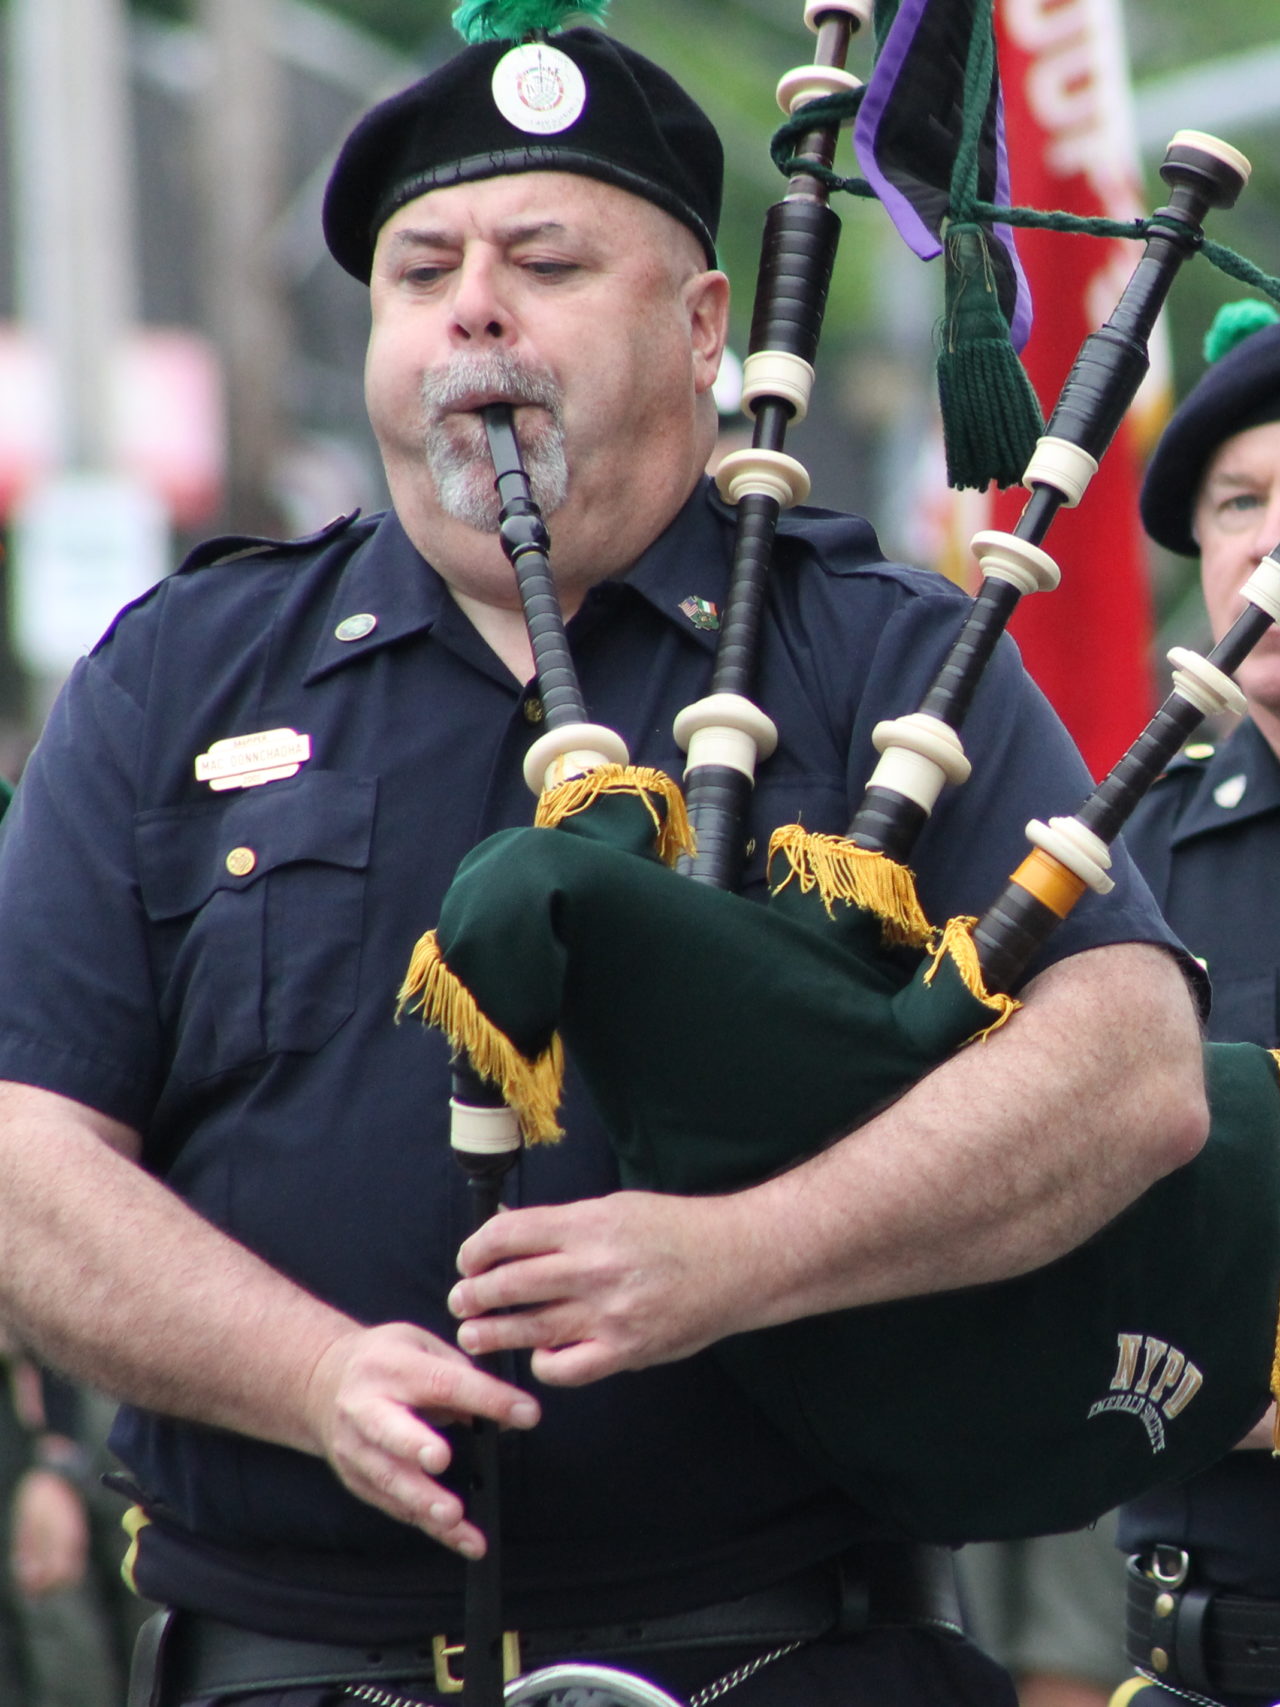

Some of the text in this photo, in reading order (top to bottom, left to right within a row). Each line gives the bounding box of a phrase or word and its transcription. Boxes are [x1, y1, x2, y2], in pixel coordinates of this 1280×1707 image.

[201, 757, 225, 771] MAC
[1109, 1333, 1203, 1420] NYPD
[1087, 1394, 1166, 1454] EMERALD SOCIETY
